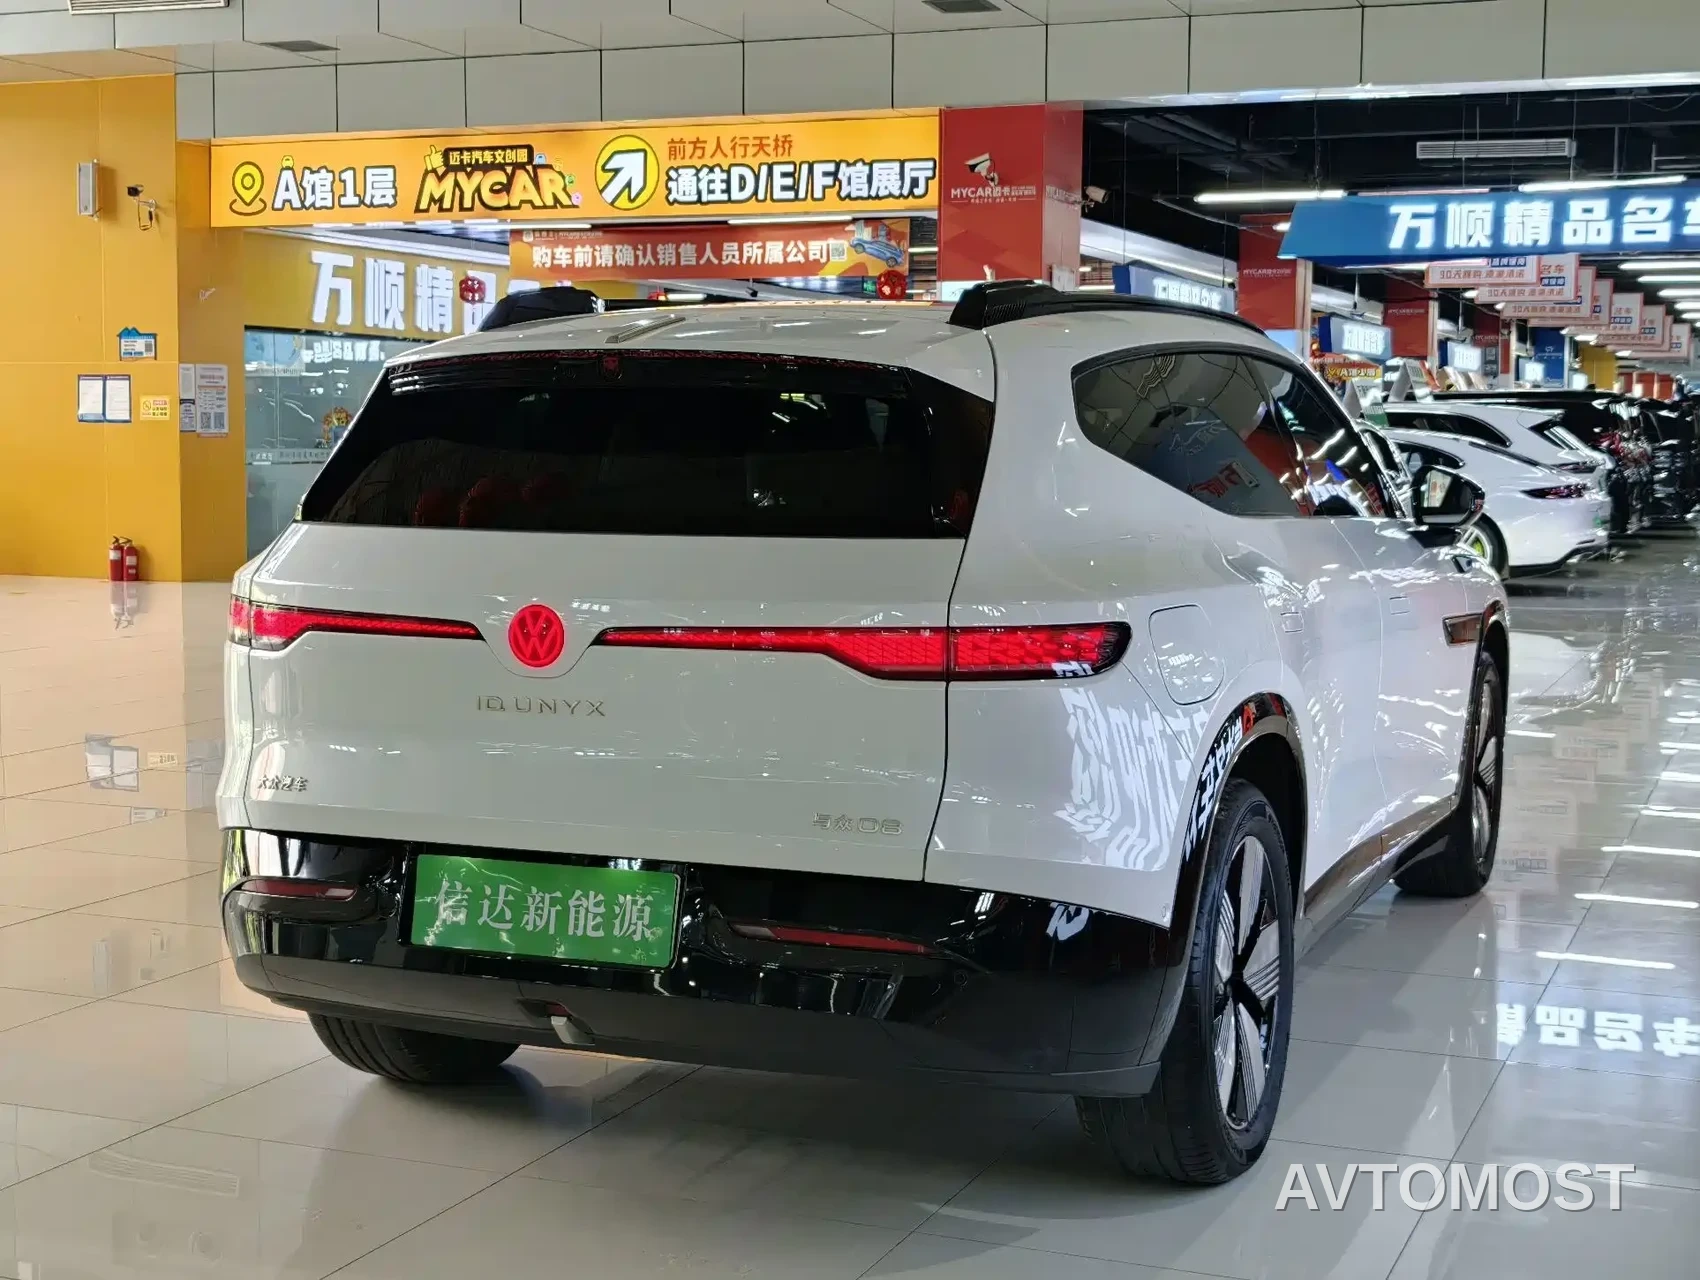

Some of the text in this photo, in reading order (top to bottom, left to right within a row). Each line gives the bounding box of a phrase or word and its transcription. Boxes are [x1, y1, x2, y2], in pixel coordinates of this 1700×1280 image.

[449, 148, 528, 165] 迈卡汽车文创园
[668, 134, 793, 160] 前方人行天桥
[273, 166, 397, 209] A馆1层
[414, 167, 578, 212] MYCAR
[667, 158, 935, 203] 通往D/E/F馆展厅
[532, 240, 830, 269] 购车前请确认销售人员所属公司
[435, 879, 654, 942] 信达新能源
